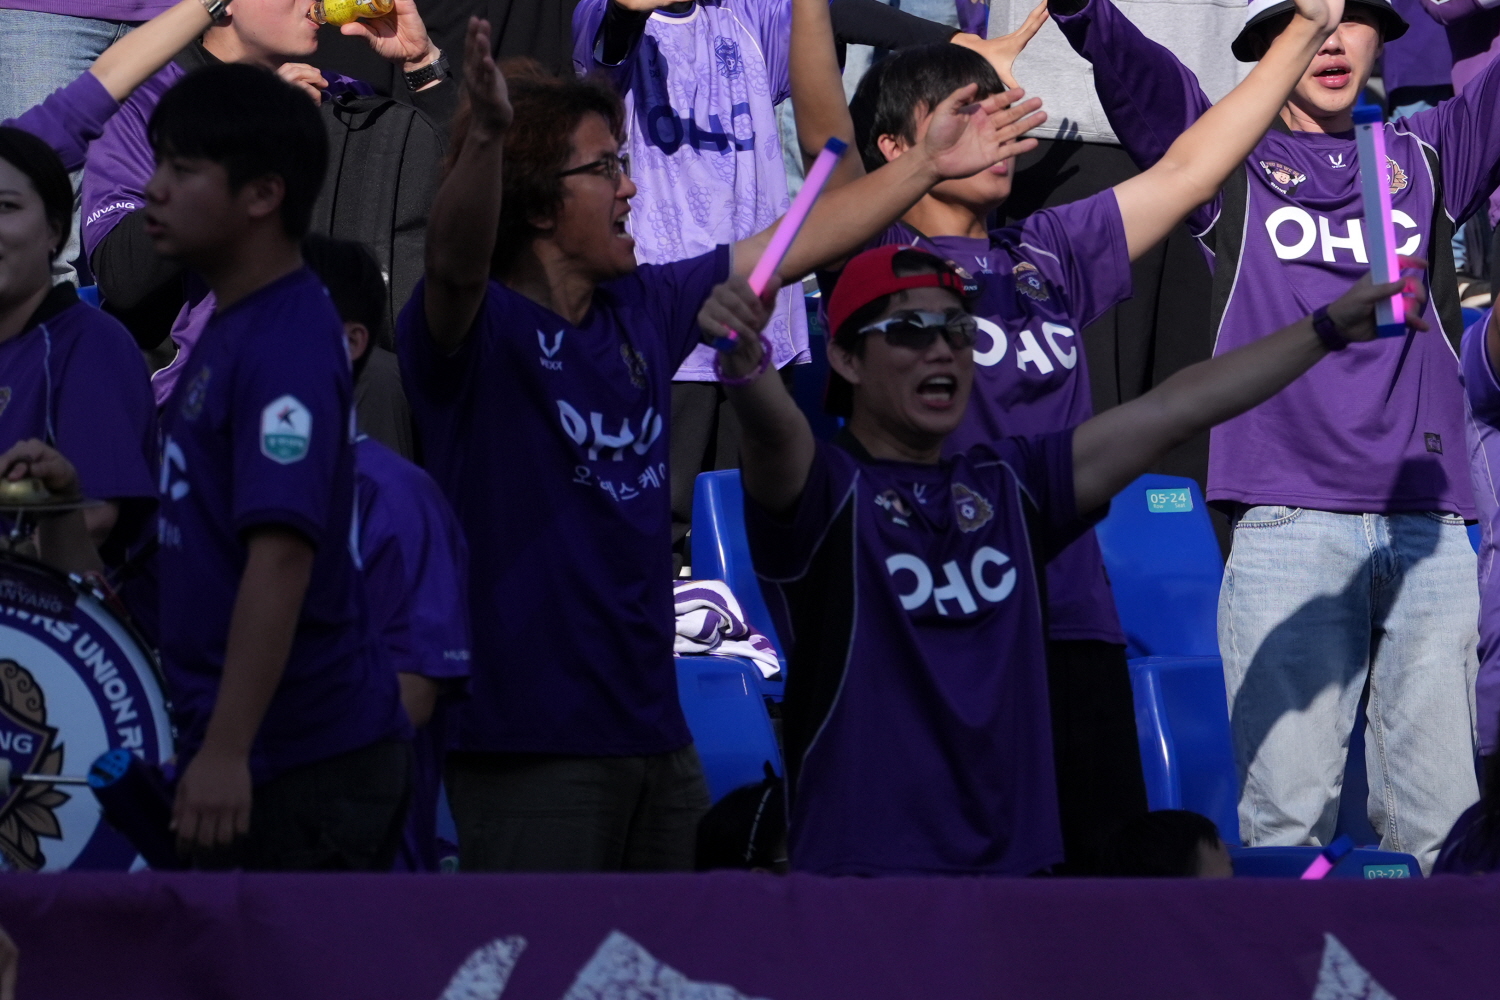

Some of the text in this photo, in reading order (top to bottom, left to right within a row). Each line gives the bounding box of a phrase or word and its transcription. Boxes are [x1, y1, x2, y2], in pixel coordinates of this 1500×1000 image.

[1265, 206, 1421, 264] OHC
[973, 316, 1077, 375] OHC
[1150, 493, 1187, 504] 05-24
[885, 546, 1017, 616] OHC
[73, 633, 138, 724] UNION
